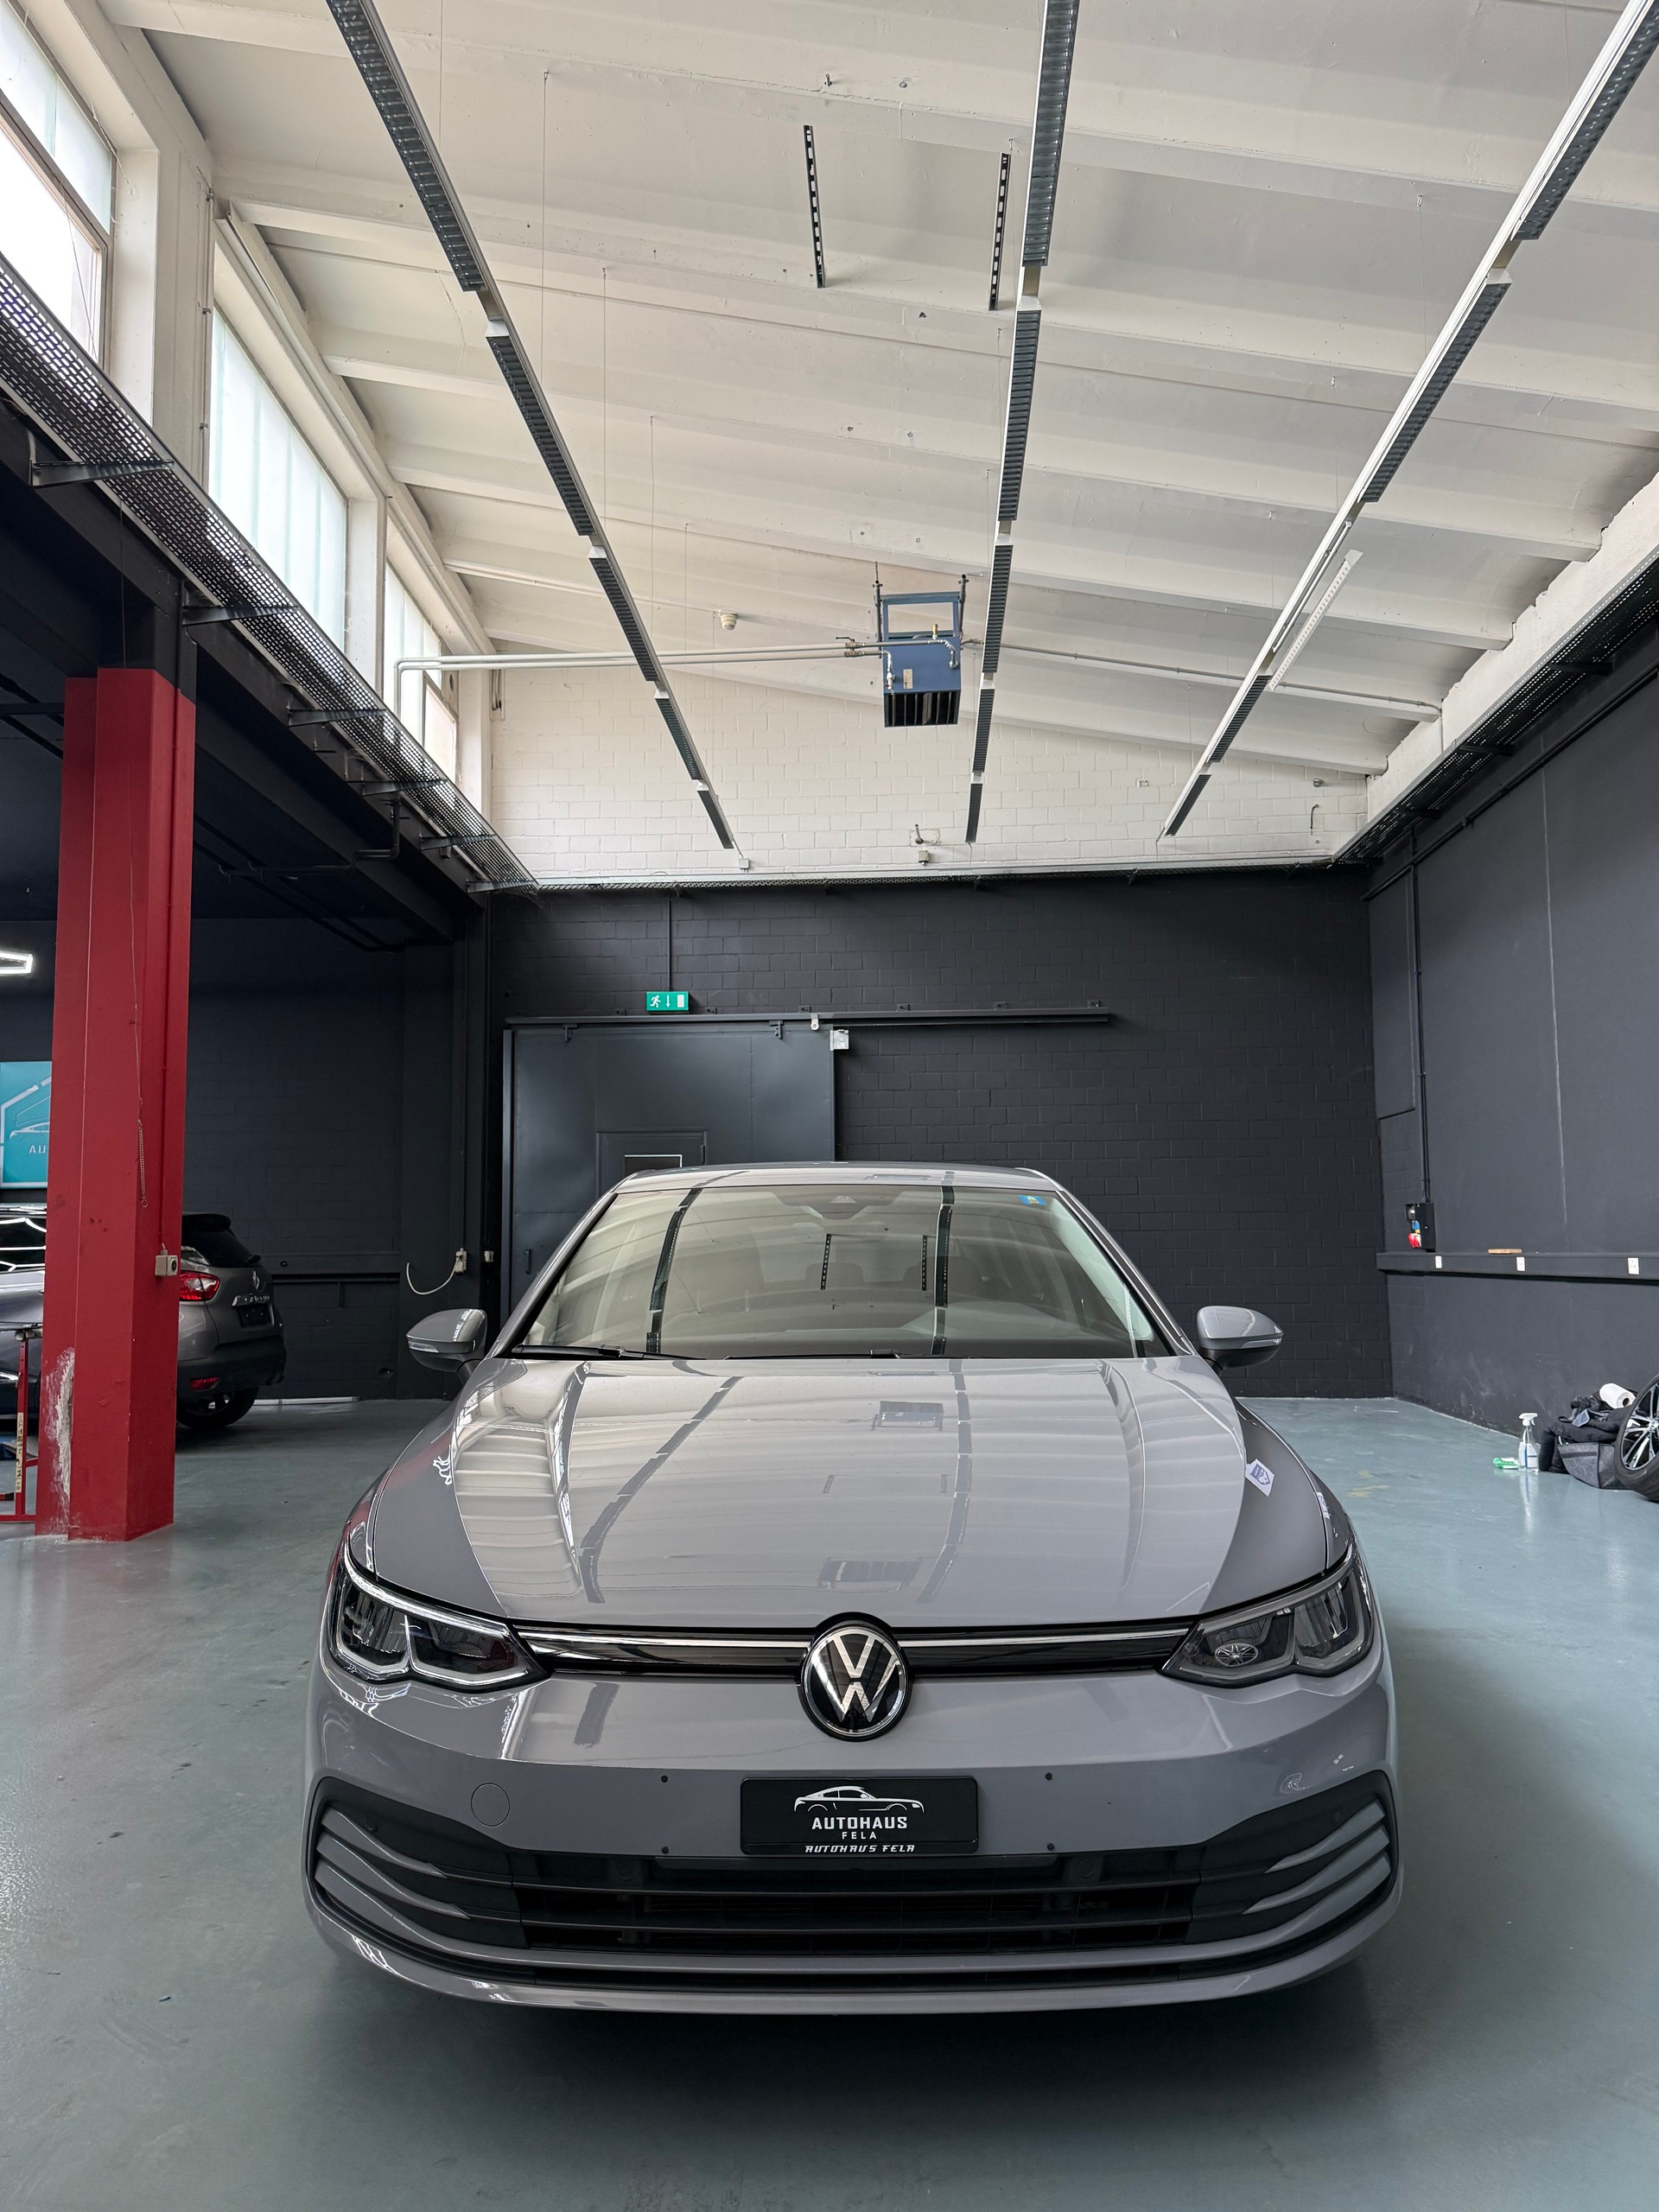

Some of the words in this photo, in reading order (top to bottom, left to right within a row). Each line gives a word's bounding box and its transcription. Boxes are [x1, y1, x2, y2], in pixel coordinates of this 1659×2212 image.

[810, 1630, 903, 1724] VW
[811, 1816, 907, 1830] AUTOHAUS
[842, 1831, 877, 1840] FELA
[804, 1845, 878, 1853] AUTOHAUS
[882, 1844, 916, 1853] FELA
